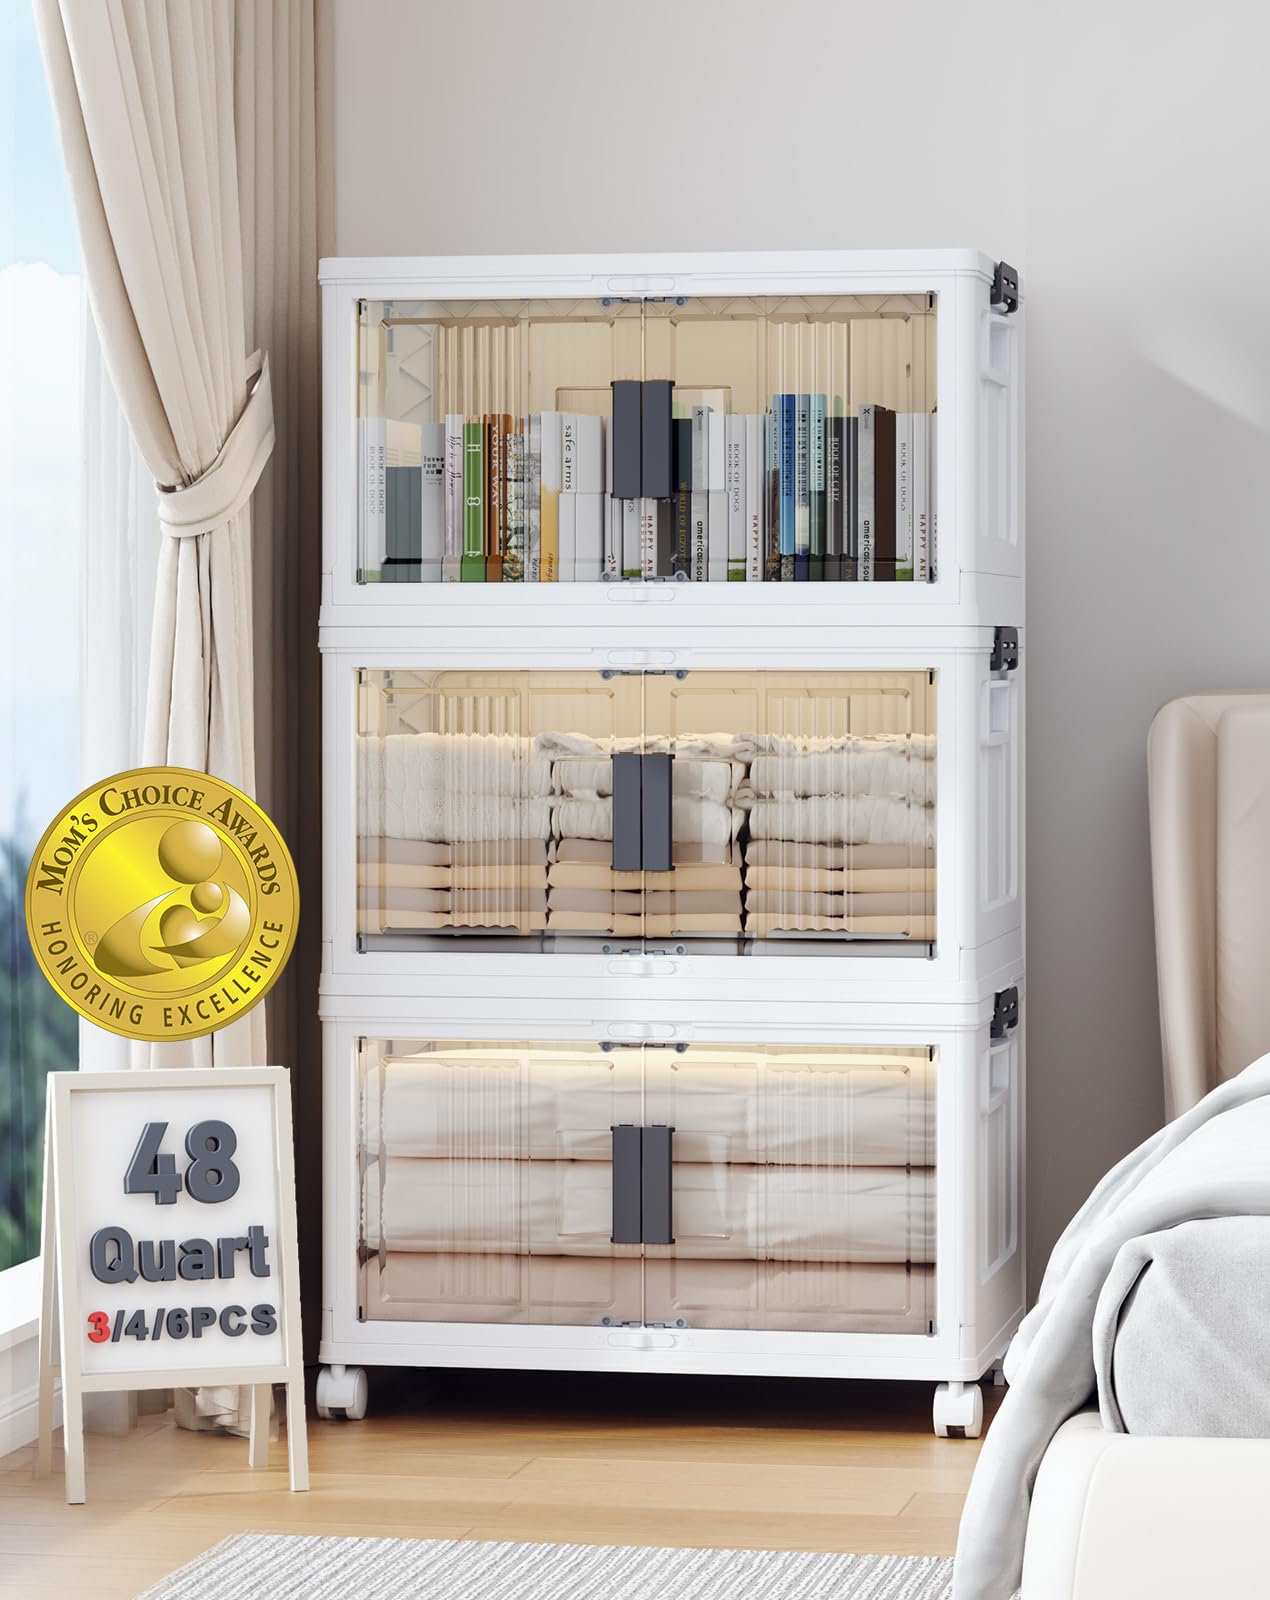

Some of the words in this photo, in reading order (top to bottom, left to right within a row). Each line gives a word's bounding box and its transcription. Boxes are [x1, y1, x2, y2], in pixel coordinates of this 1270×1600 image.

[565, 425, 576, 452] safe
[733, 472, 740, 483] OF
[124, 1119, 240, 1205] 48
[90, 1225, 271, 1284] Quart
[87, 1303, 278, 1344] 3/4/6PCS
